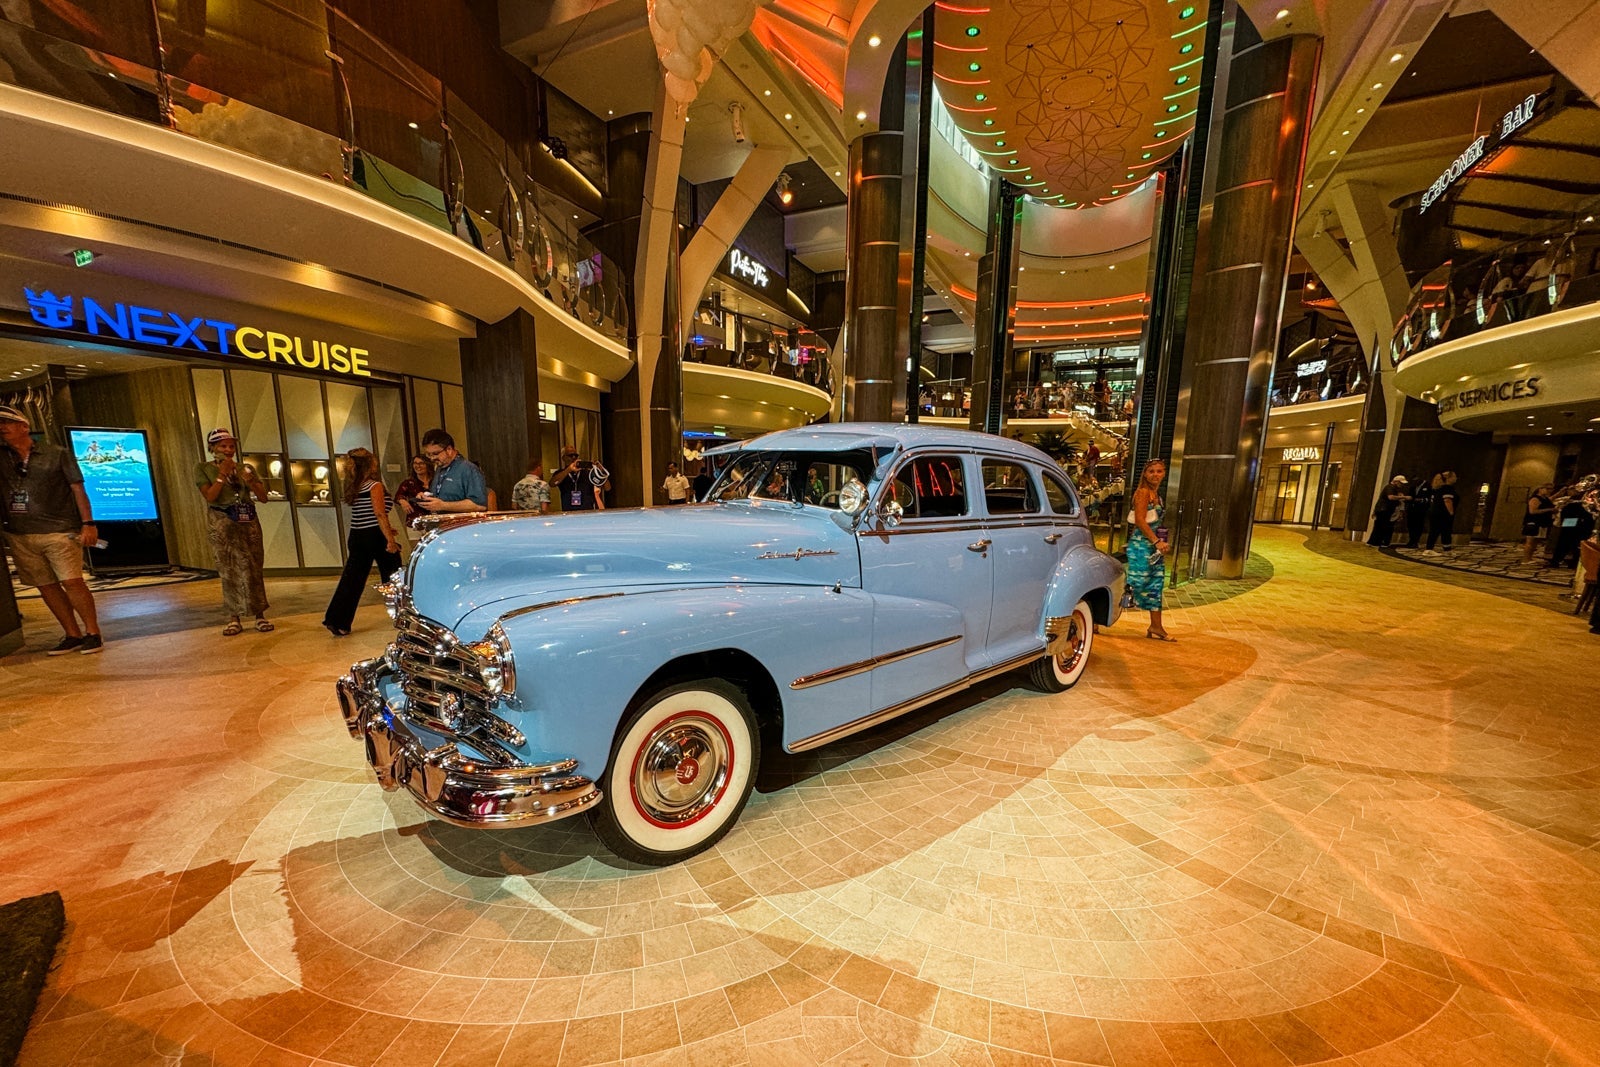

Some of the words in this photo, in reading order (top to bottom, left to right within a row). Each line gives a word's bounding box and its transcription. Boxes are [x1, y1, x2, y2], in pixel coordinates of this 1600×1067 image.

[1419, 135, 1485, 215] SCHOONER
[1500, 94, 1536, 140] BAR
[1459, 377, 1542, 410] SERVICES
[1282, 447, 1320, 461] REGALIA
